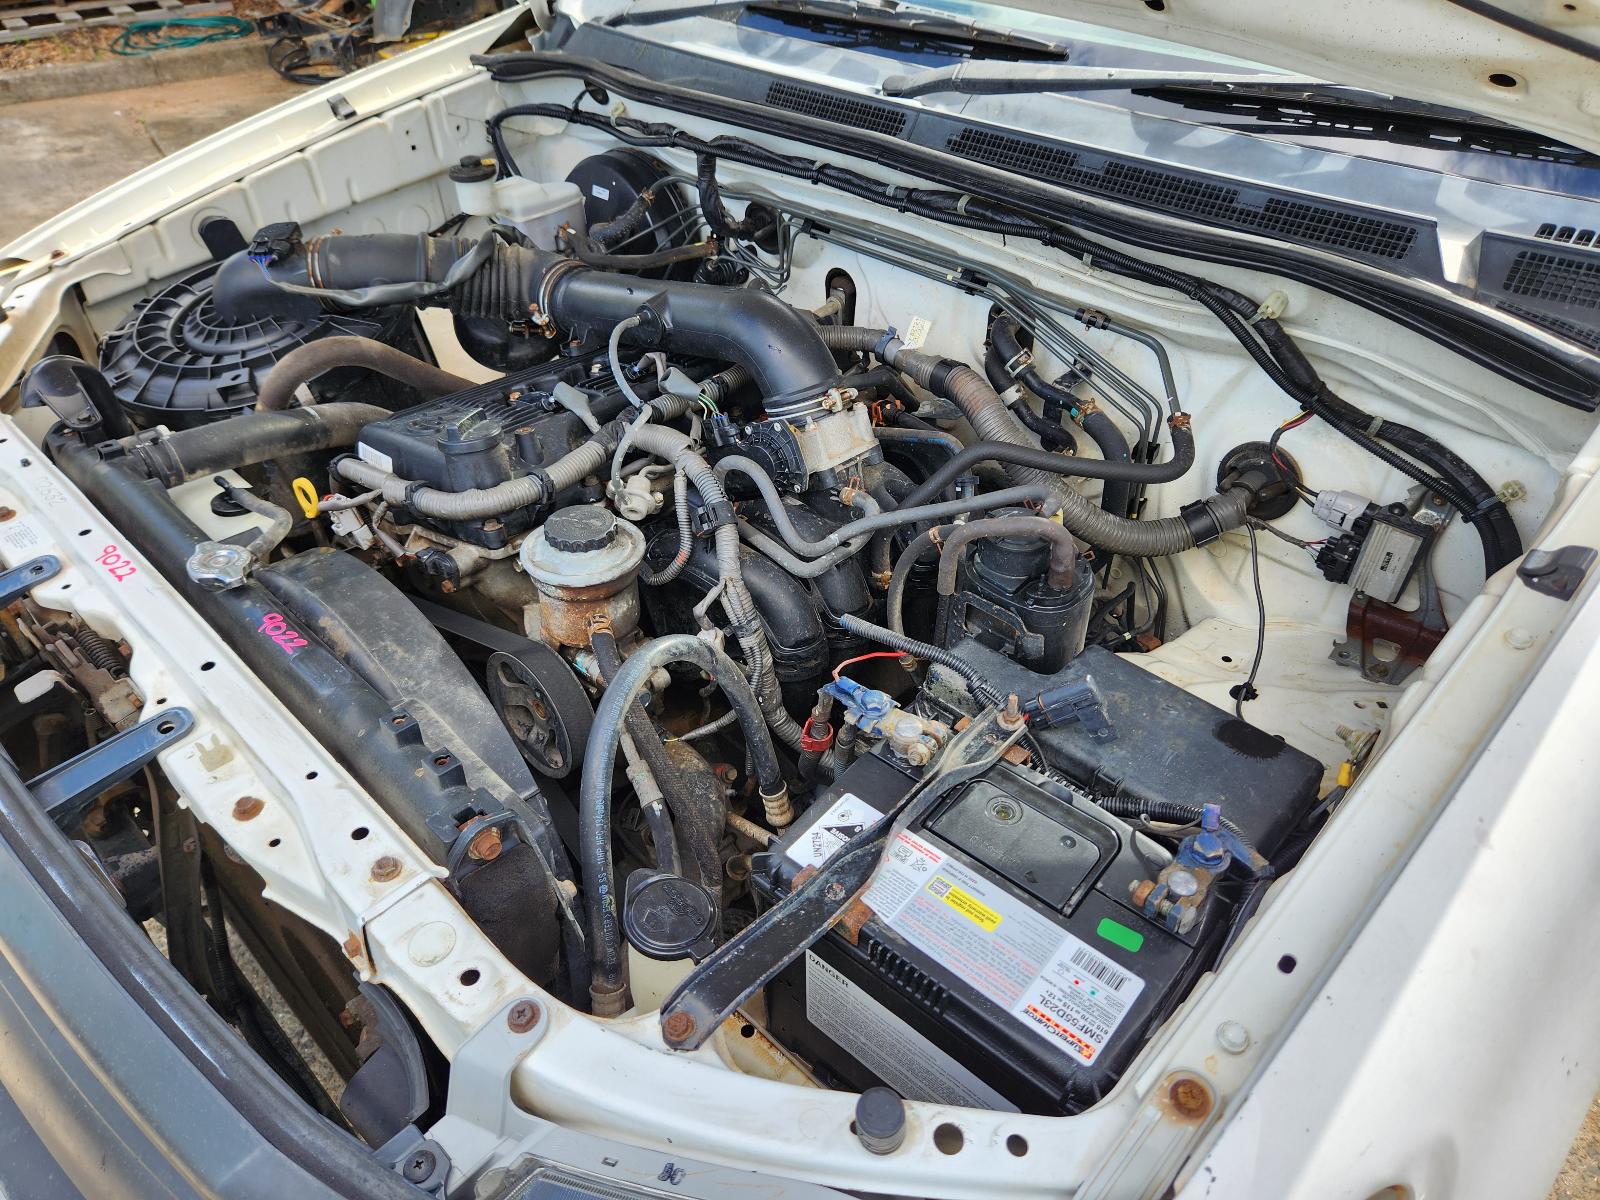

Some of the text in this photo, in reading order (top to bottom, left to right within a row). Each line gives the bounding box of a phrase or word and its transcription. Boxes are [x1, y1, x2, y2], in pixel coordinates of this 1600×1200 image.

[96, 545, 136, 582] 9022
[258, 612, 308, 653] 9022
[855, 824, 862, 833] 8
[808, 952, 850, 989] DANGER
[1039, 993, 1105, 1045] SMF55D23L
